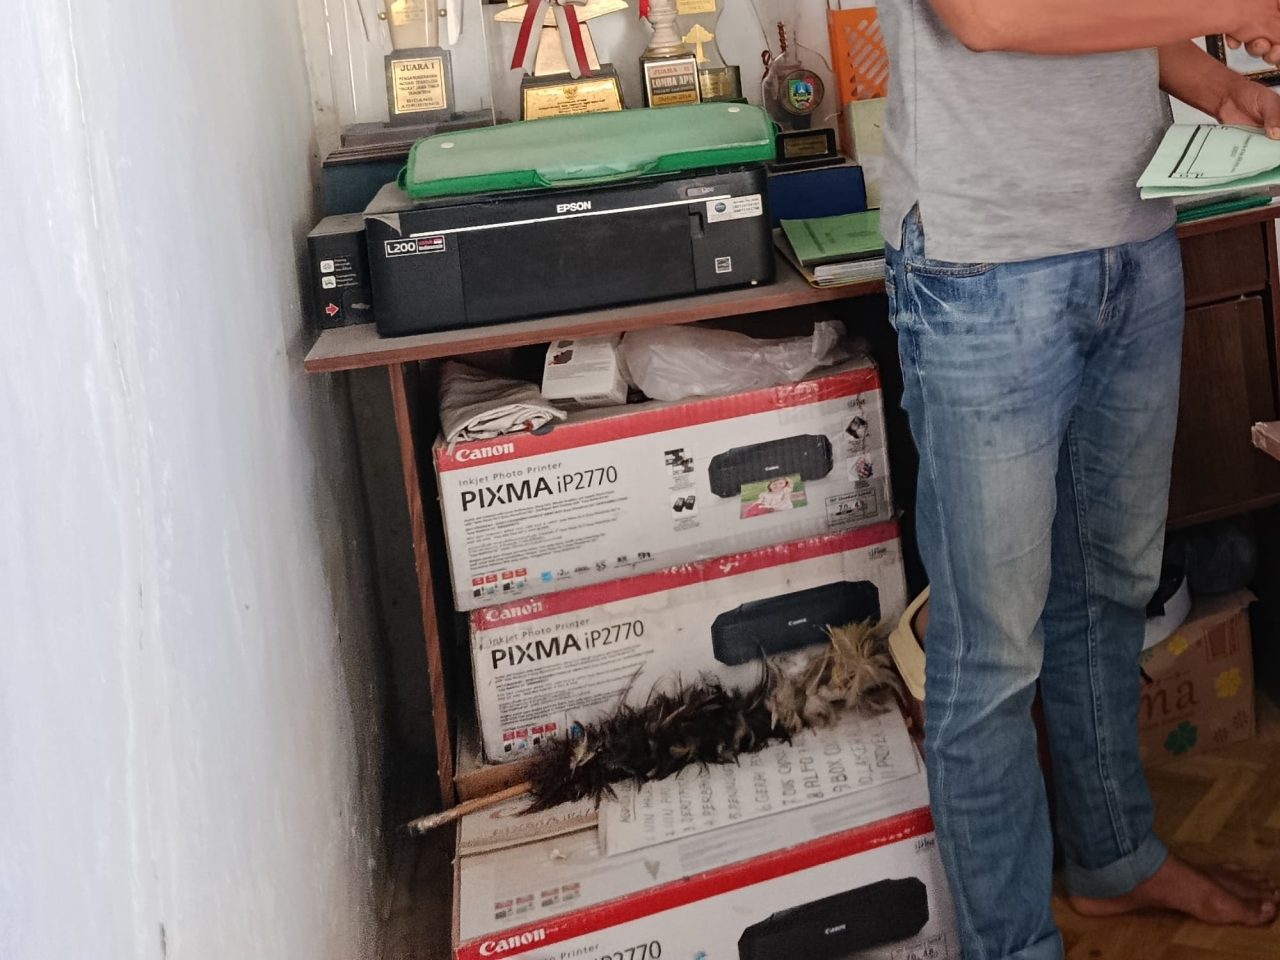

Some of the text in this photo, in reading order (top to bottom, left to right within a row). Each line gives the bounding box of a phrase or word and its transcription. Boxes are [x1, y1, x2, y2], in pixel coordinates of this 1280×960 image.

[400, 62, 430, 72] JUARA
[652, 76, 677, 88] LOMBA
[556, 200, 592, 214] EPSON
[386, 242, 416, 254] L200
[456, 442, 514, 462] Canon
[458, 462, 562, 488] Inkjet Photo Printer
[461, 465, 618, 512] PIXMA iP2770
[486, 600, 544, 622] Canon
[489, 618, 590, 646] Inkjet Photo Printer
[491, 620, 644, 670] PIXMA iP2770
[824, 924, 846, 934] Canon
[479, 927, 546, 958] Canon
[560, 944, 600, 960] Printer
